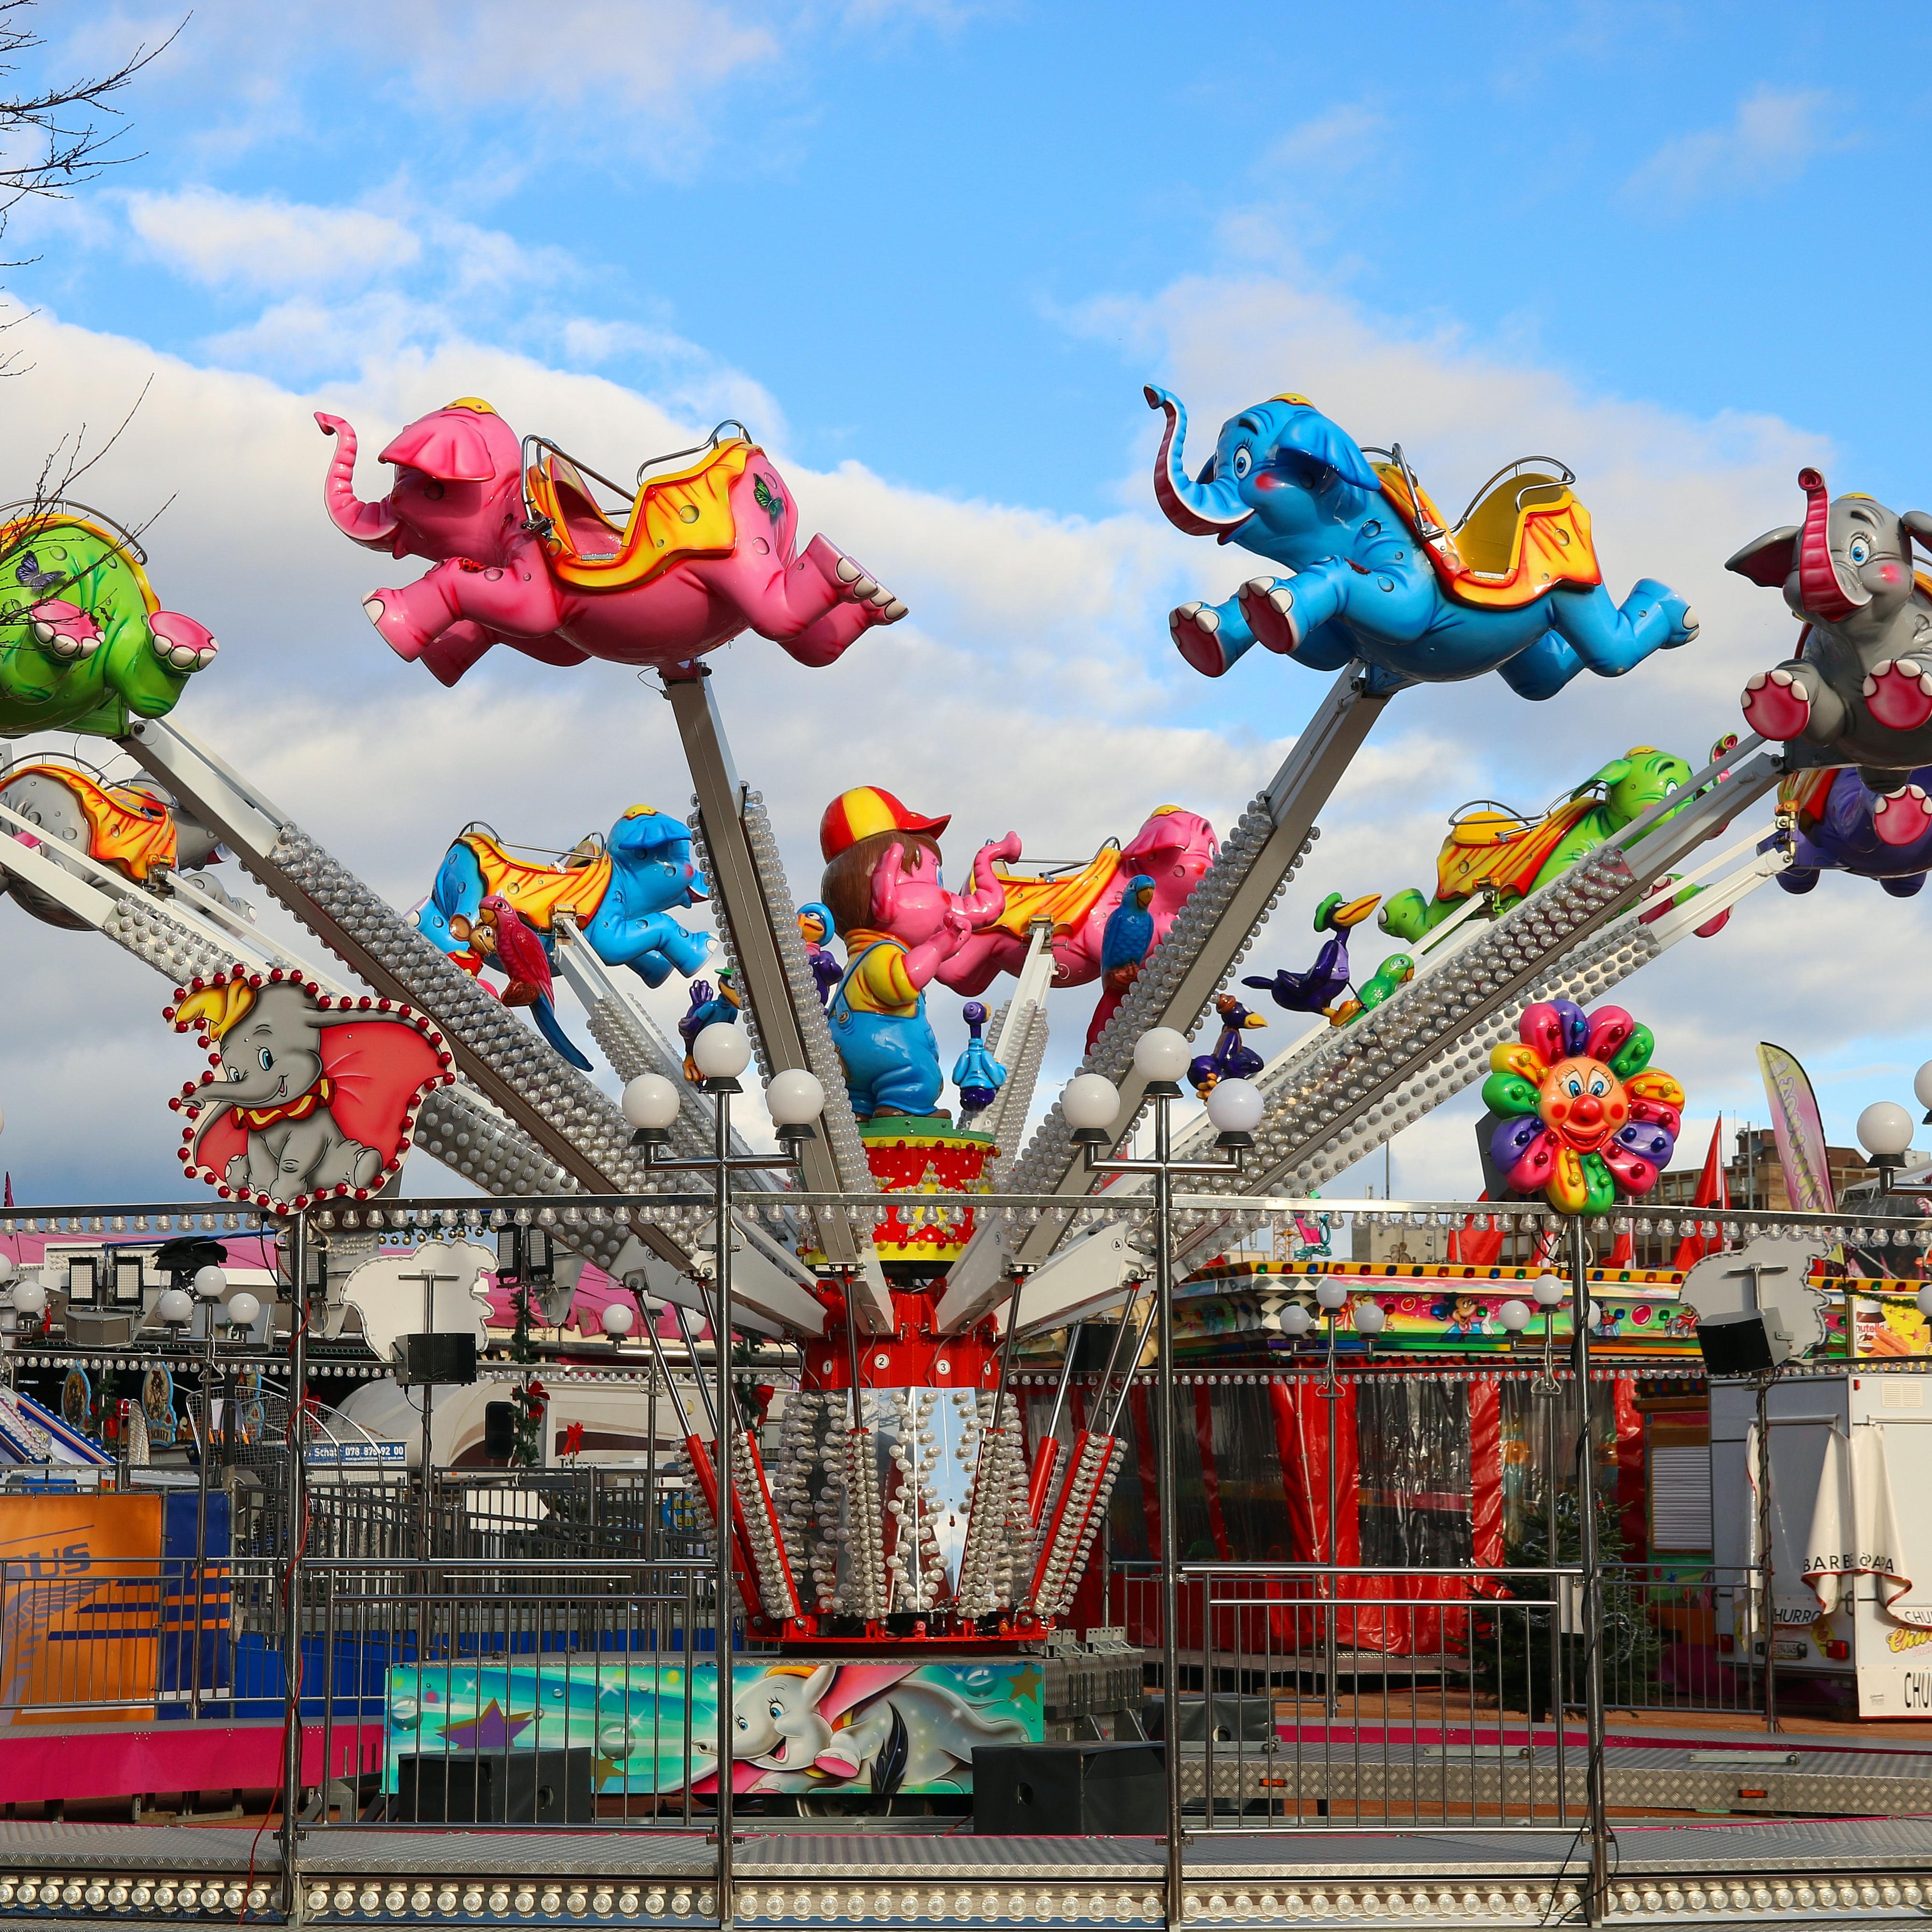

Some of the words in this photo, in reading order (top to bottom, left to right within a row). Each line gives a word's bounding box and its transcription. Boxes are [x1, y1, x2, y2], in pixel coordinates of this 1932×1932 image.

[1856, 1322, 1884, 1333] nutella
[879, 1357, 884, 1366] 2
[940, 1363, 946, 1371] 3
[394, 1446, 403, 1455] 00
[1904, 1611, 1932, 1624] CHU
[1904, 1672, 1932, 1708] CHU
